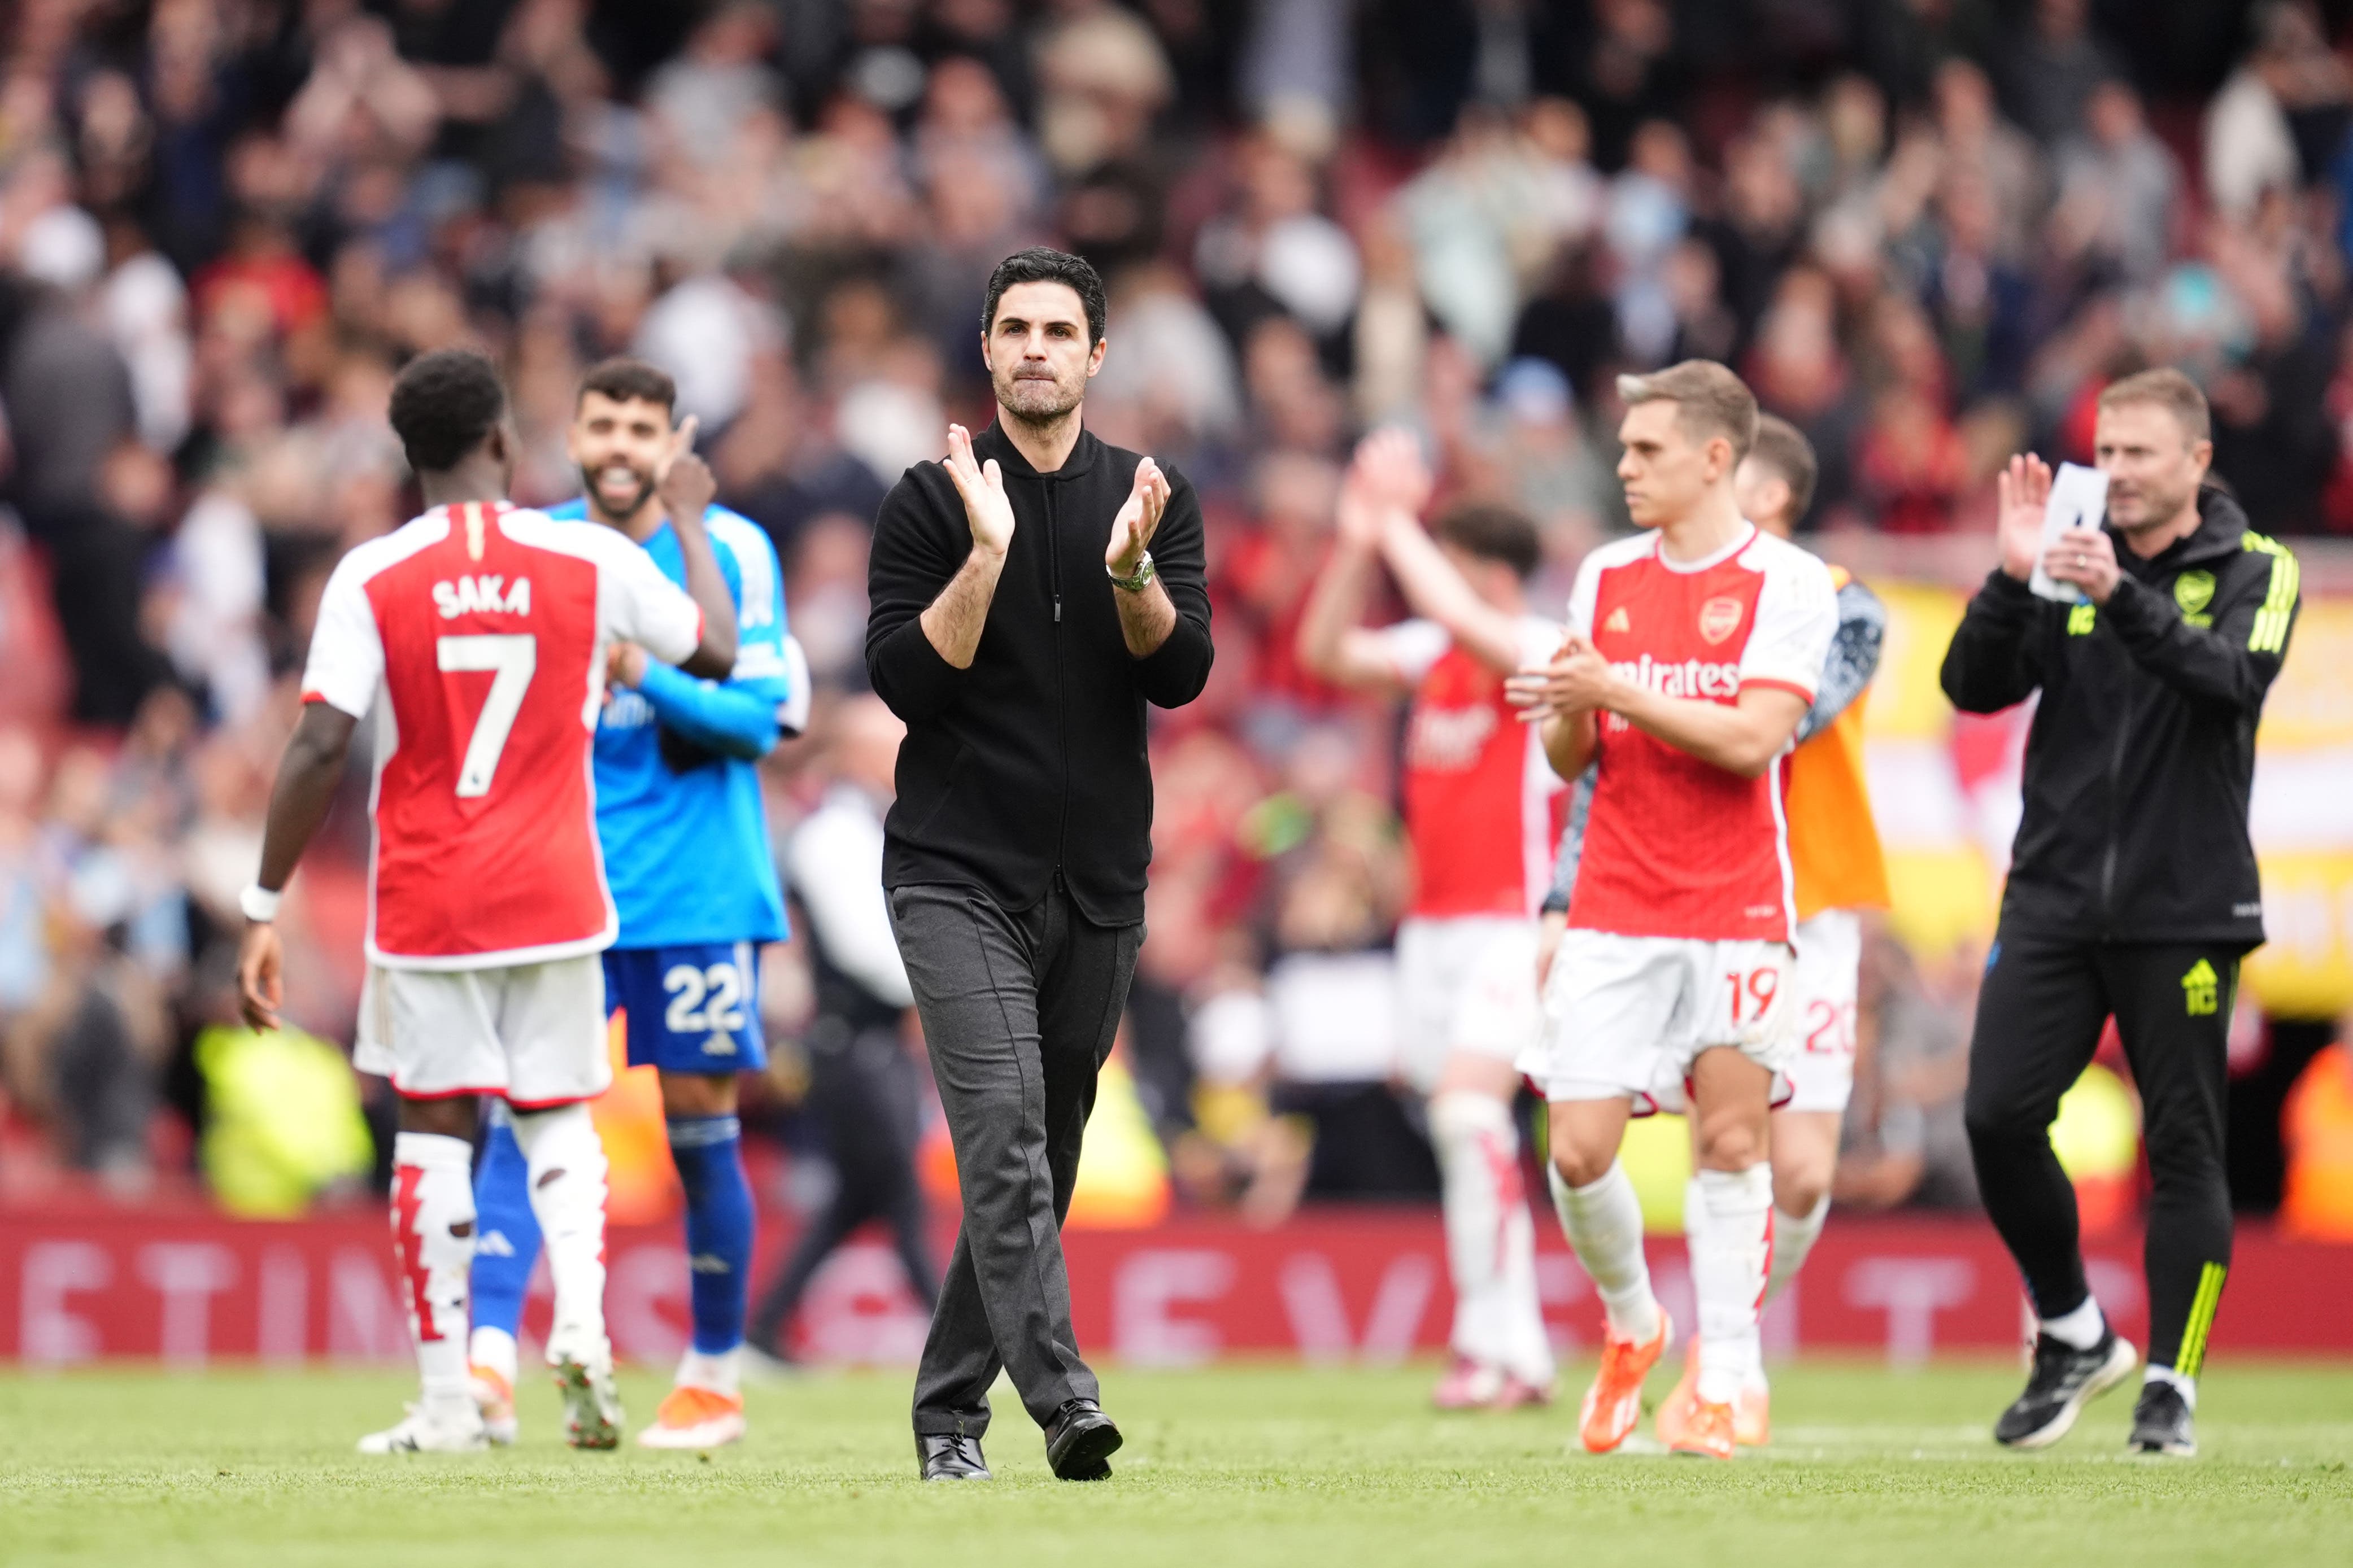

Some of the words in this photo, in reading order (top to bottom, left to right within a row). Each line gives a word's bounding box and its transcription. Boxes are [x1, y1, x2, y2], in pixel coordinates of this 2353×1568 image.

[432, 574, 531, 620] SAKA
[1606, 653, 1740, 697] mirates
[437, 633, 537, 798] 7
[664, 962, 746, 1033] 22
[1727, 967, 1779, 1028] 19
[20, 1242, 695, 1373] ETINS
[1110, 1249, 2141, 1373] EVT
